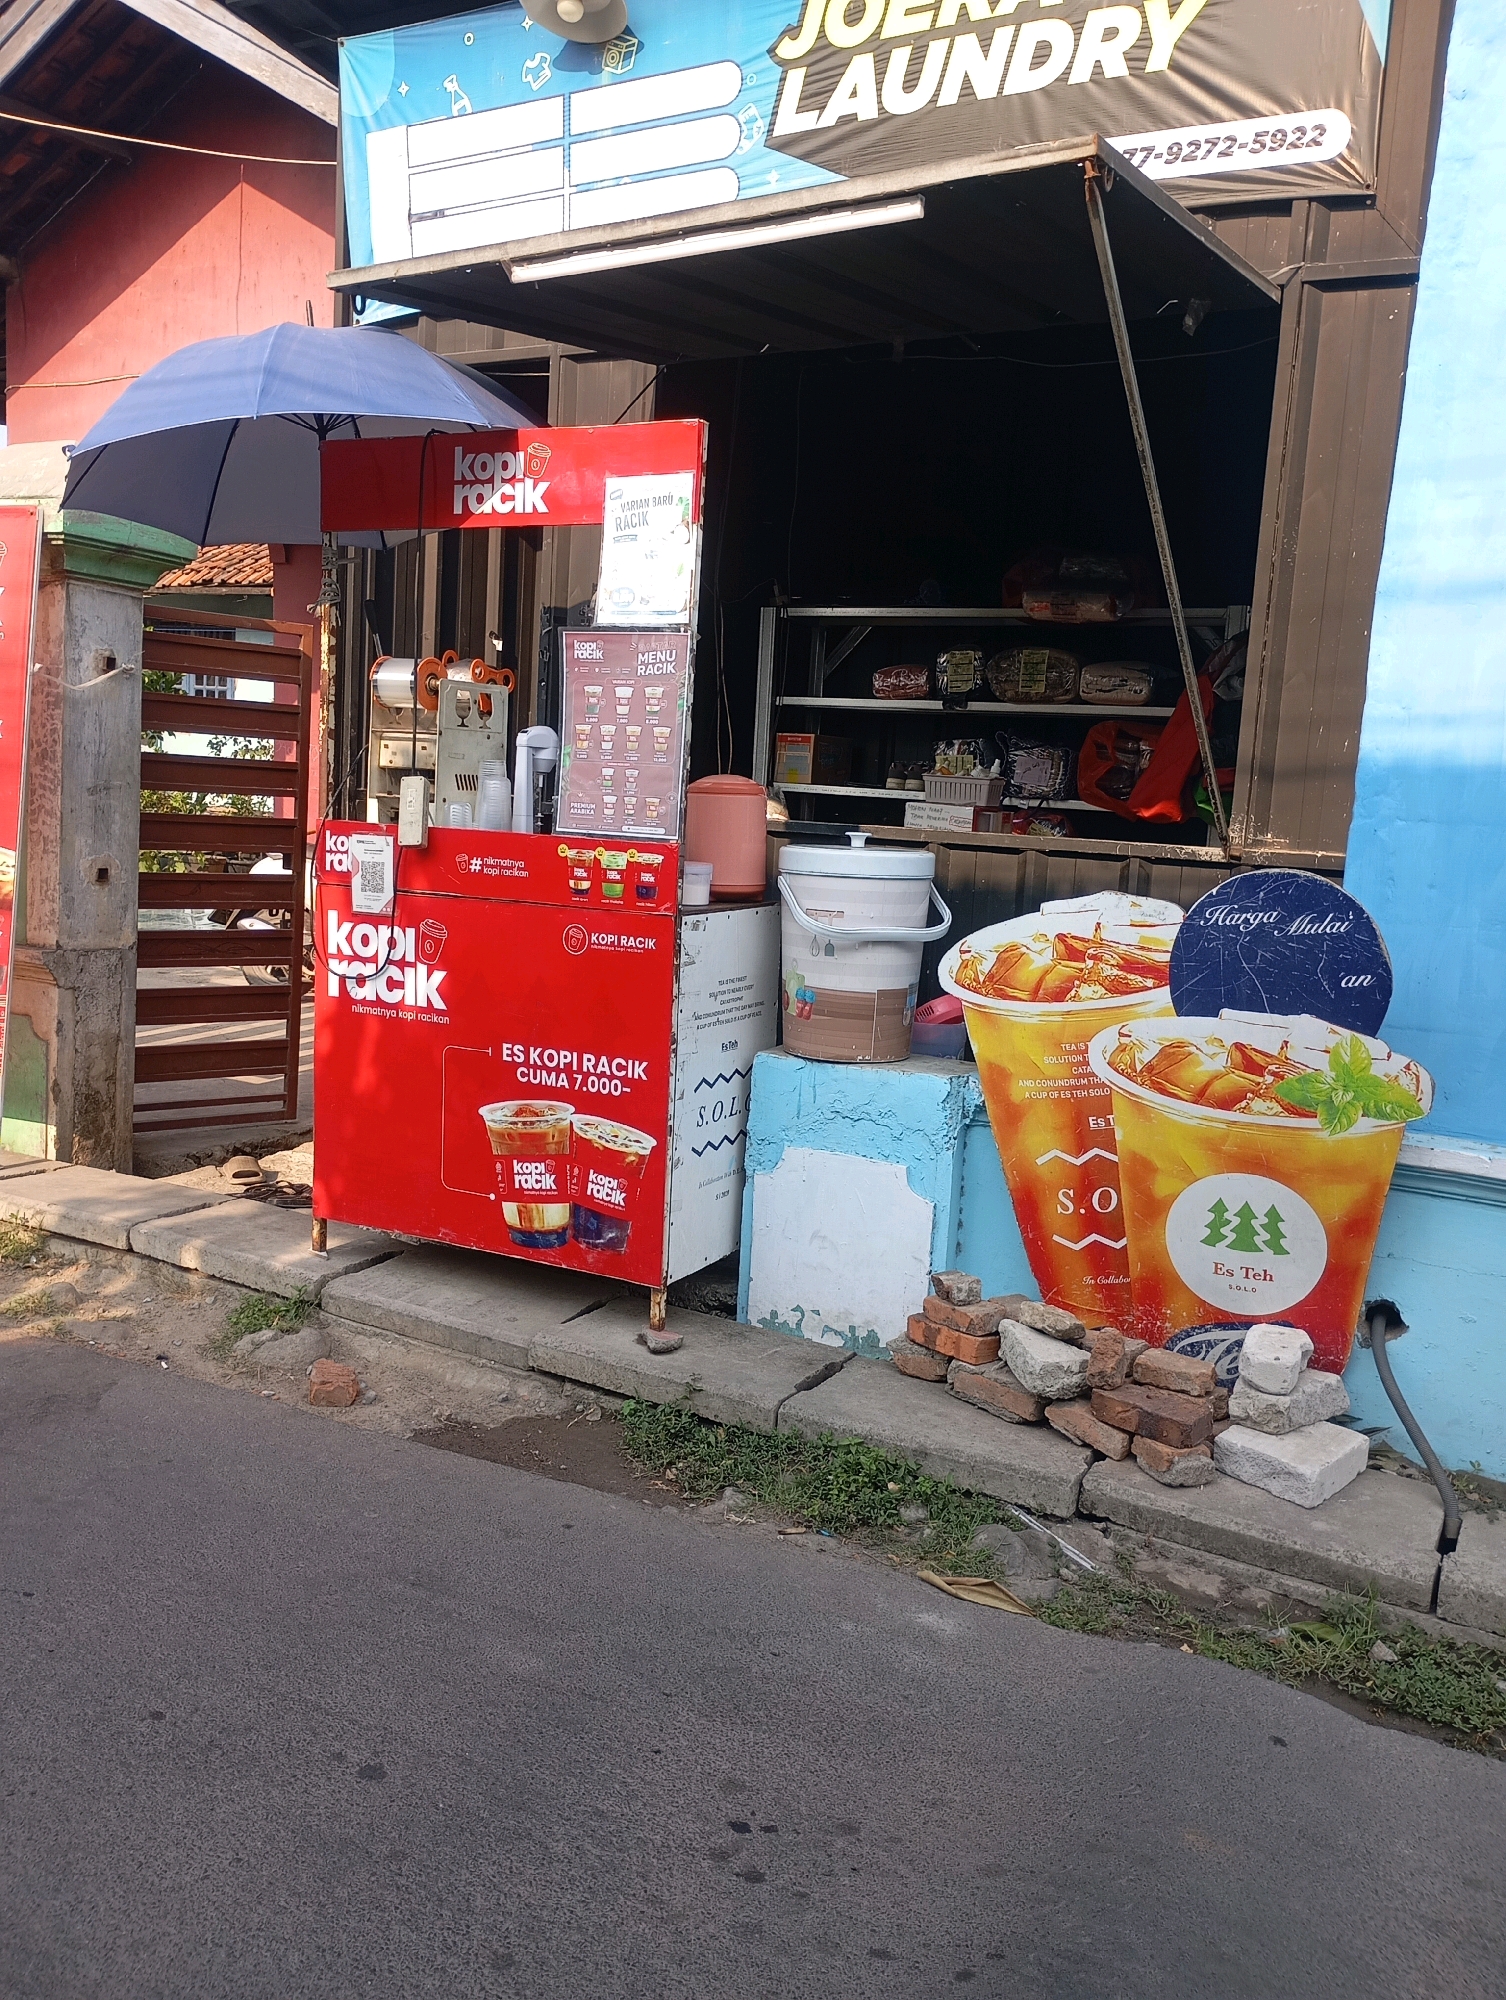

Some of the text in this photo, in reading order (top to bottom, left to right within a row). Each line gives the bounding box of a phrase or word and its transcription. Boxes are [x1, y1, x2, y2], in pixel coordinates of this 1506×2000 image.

[772, 0, 1206, 138] LAUNDRY
[454, 446, 524, 495] kopi
[453, 477, 551, 514] racik
[620, 498, 650, 513] VARIAN
[614, 511, 649, 532] RACIK
[574, 640, 597, 655] kopi
[574, 650, 676, 664] racik MENU
[636, 662, 676, 676] RACIK
[483, 856, 525, 873] nikmatnya
[483, 865, 529, 878] kopi racikan
[1200, 904, 1353, 937] Harga Mulai
[327, 909, 416, 974] kopi
[591, 932, 657, 950] KOPI RACIK
[327, 960, 448, 1011] racik
[351, 1003, 450, 1025] nikmatnya kopi racikan
[1061, 1043, 1077, 1051] TEA
[1077, 1042, 1086, 1051] IS
[502, 1042, 649, 1081] ES KOPI RACIK
[1043, 1055, 1083, 1064] SOLUTION
[516, 1067, 632, 1097] CUMA 7.000-
[1018, 1079, 1035, 1088] AND
[1035, 1078, 1089, 1088] CONUNDRUM
[1031, 1090, 1048, 1100] CUP
[1048, 1090, 1060, 1099] OF
[1060, 1090, 1071, 1099] ES
[1071, 1089, 1089, 1098] TEH
[1088, 1086, 1111, 1097] SOLO
[1088, 1116, 1106, 1128] Es
[513, 1159, 545, 1178] kopi
[514, 1173, 557, 1190] racik
[589, 1168, 620, 1192] kopi
[586, 1181, 628, 1206] racik
[1081, 1275, 1096, 1285] In
[1212, 1261, 1275, 1283] Es Teh
[1228, 1283, 1257, 1294] S.O.L.O
